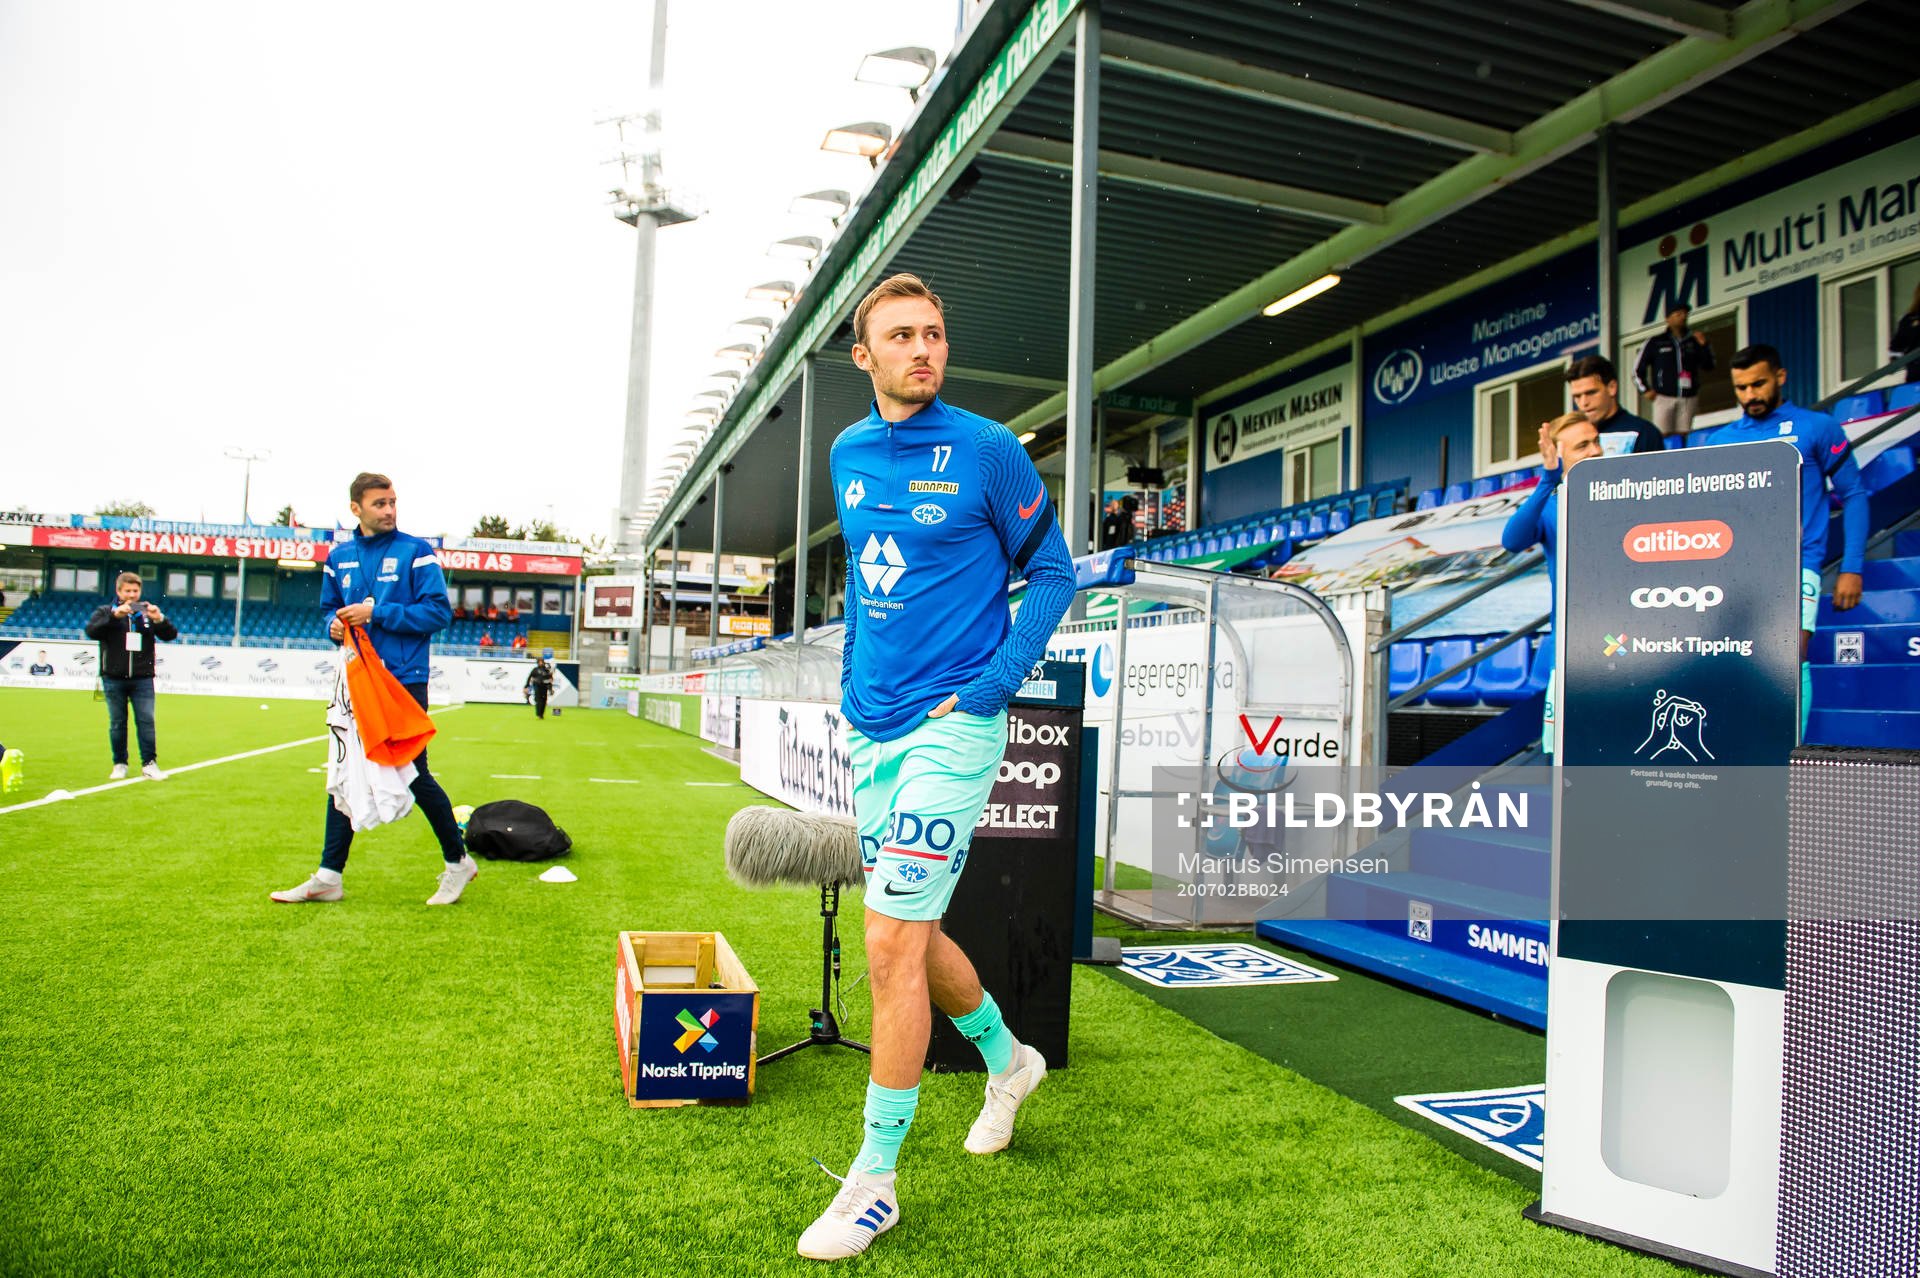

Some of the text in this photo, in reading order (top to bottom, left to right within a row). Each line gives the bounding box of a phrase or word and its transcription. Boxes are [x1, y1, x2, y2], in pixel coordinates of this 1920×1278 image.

[956, 62, 1002, 152] notar
[1723, 202, 1827, 277] Multi
[1757, 247, 1845, 284] Bemanning
[1472, 302, 1547, 343] Maritime
[1430, 312, 1600, 386] Waste Management
[1241, 403, 1287, 437] MEKVIK
[1289, 382, 1343, 421] MASKIN
[931, 445, 953, 473] 17
[909, 481, 959, 494] BUNNPRIS
[1588, 470, 1772, 502] Håndhygiene leveres av:
[109, 530, 207, 555] STRAND
[212, 537, 229, 557] &
[235, 539, 316, 561] STUBØ
[1632, 528, 1722, 554] altibox
[483, 553, 513, 571] AS
[1630, 585, 1724, 612] coop
[1632, 636, 1753, 656] Norsk Tipping
[1021, 681, 1054, 696] SERIEN
[1008, 715, 1070, 746] ibox
[1238, 713, 1339, 758] Varde
[996, 760, 1061, 790] oop
[975, 803, 1059, 830] SELECT
[1467, 923, 1550, 968] SAMMEN
[642, 1062, 746, 1080] Norsk Tipping
